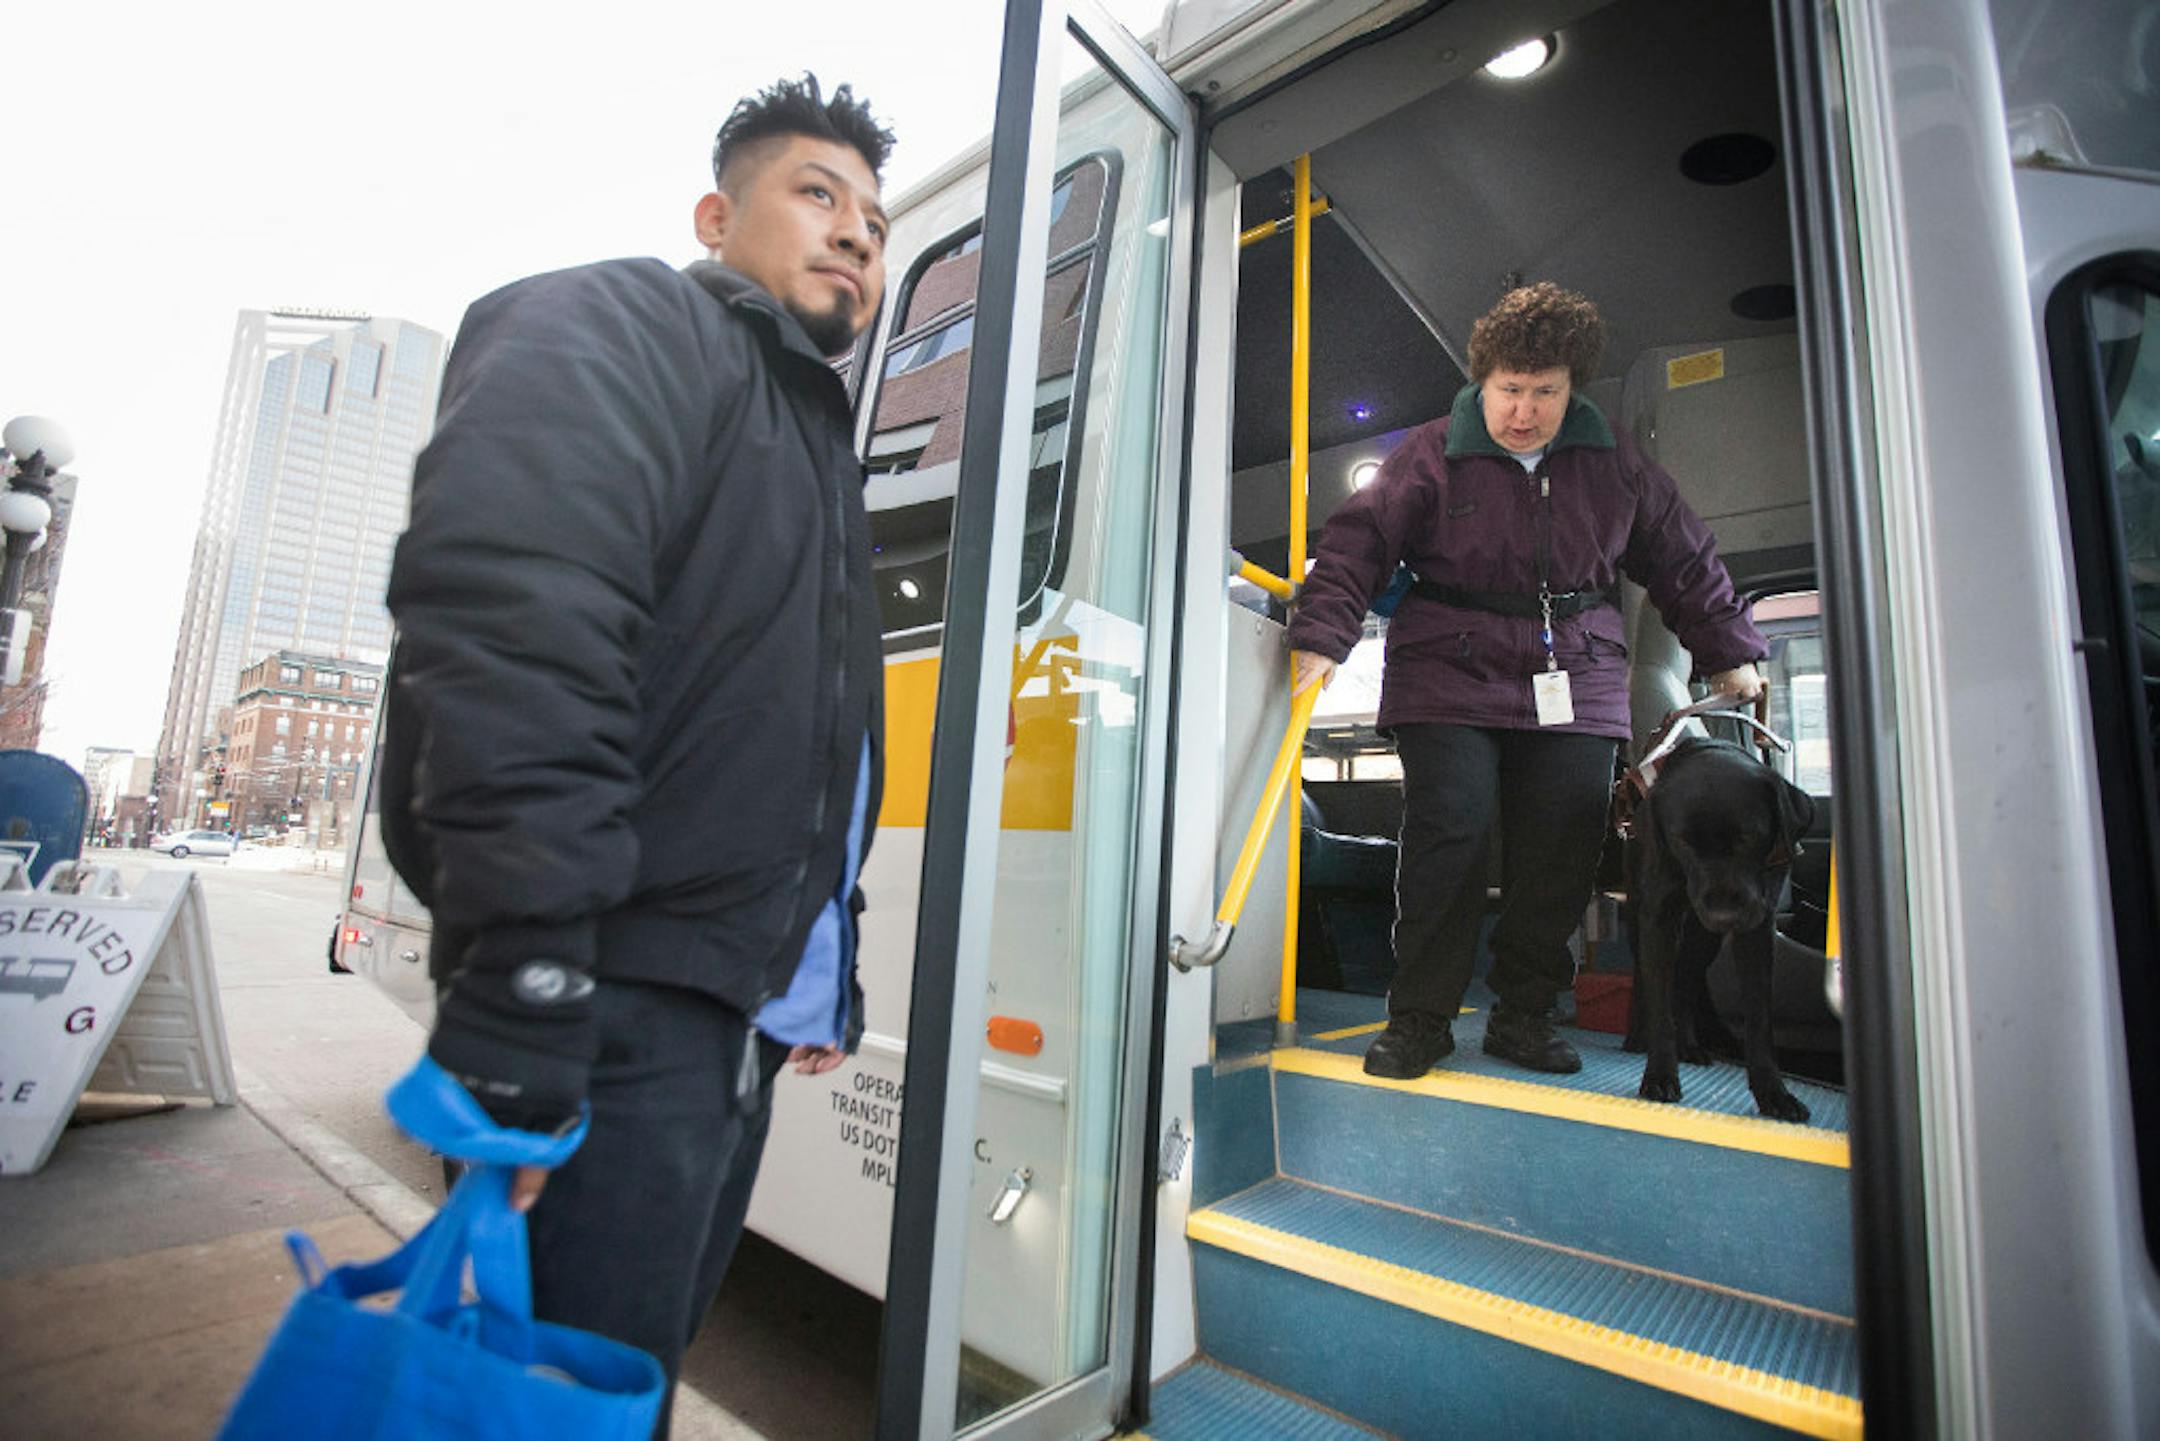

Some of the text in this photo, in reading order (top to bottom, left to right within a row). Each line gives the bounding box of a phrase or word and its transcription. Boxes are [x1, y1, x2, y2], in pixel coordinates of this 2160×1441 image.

[65, 1005, 95, 1034] G
[831, 1089, 894, 1129] TRANSIT
[841, 1120, 896, 1158] US DOT
